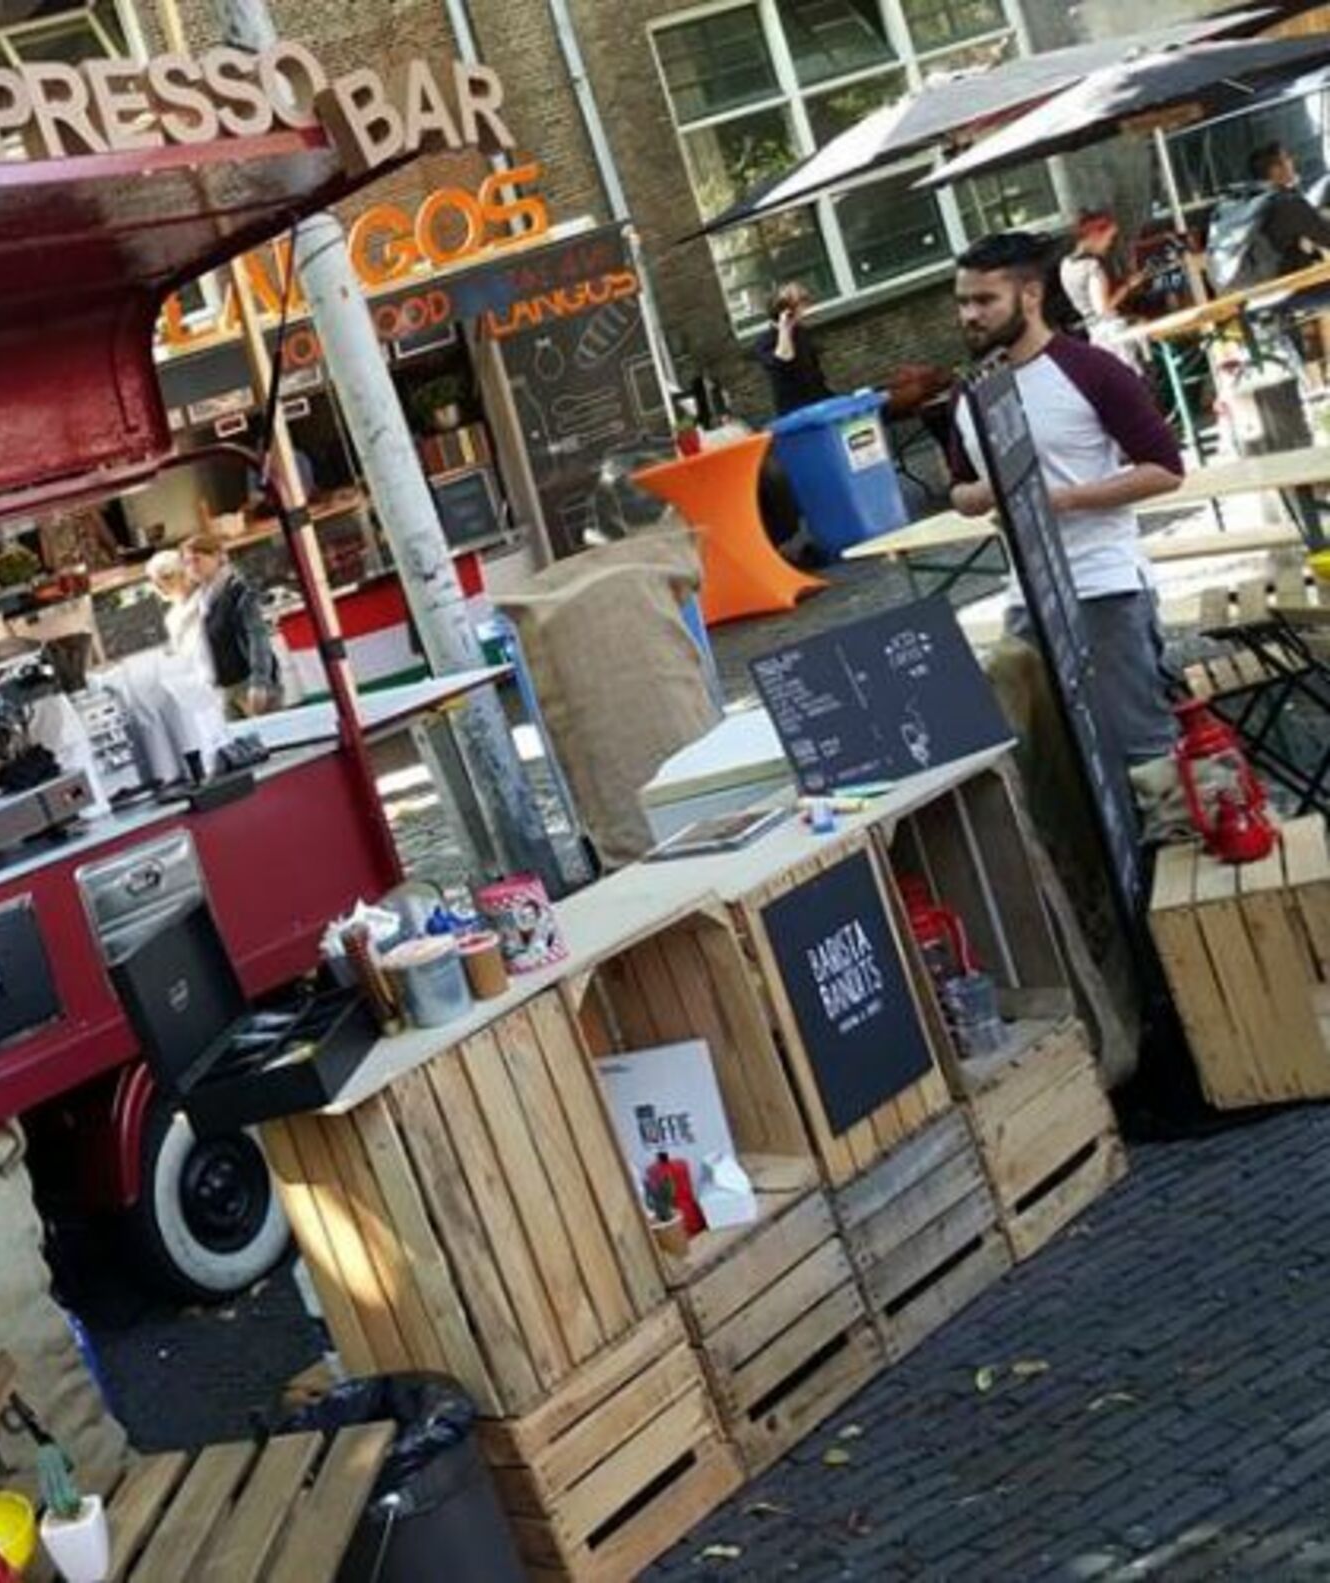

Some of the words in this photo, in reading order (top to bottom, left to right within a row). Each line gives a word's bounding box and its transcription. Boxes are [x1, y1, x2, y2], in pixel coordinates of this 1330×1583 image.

[334, 60, 516, 167] BAR
[373, 290, 450, 340] OOD
[819, 955, 883, 1020] BANDITS
